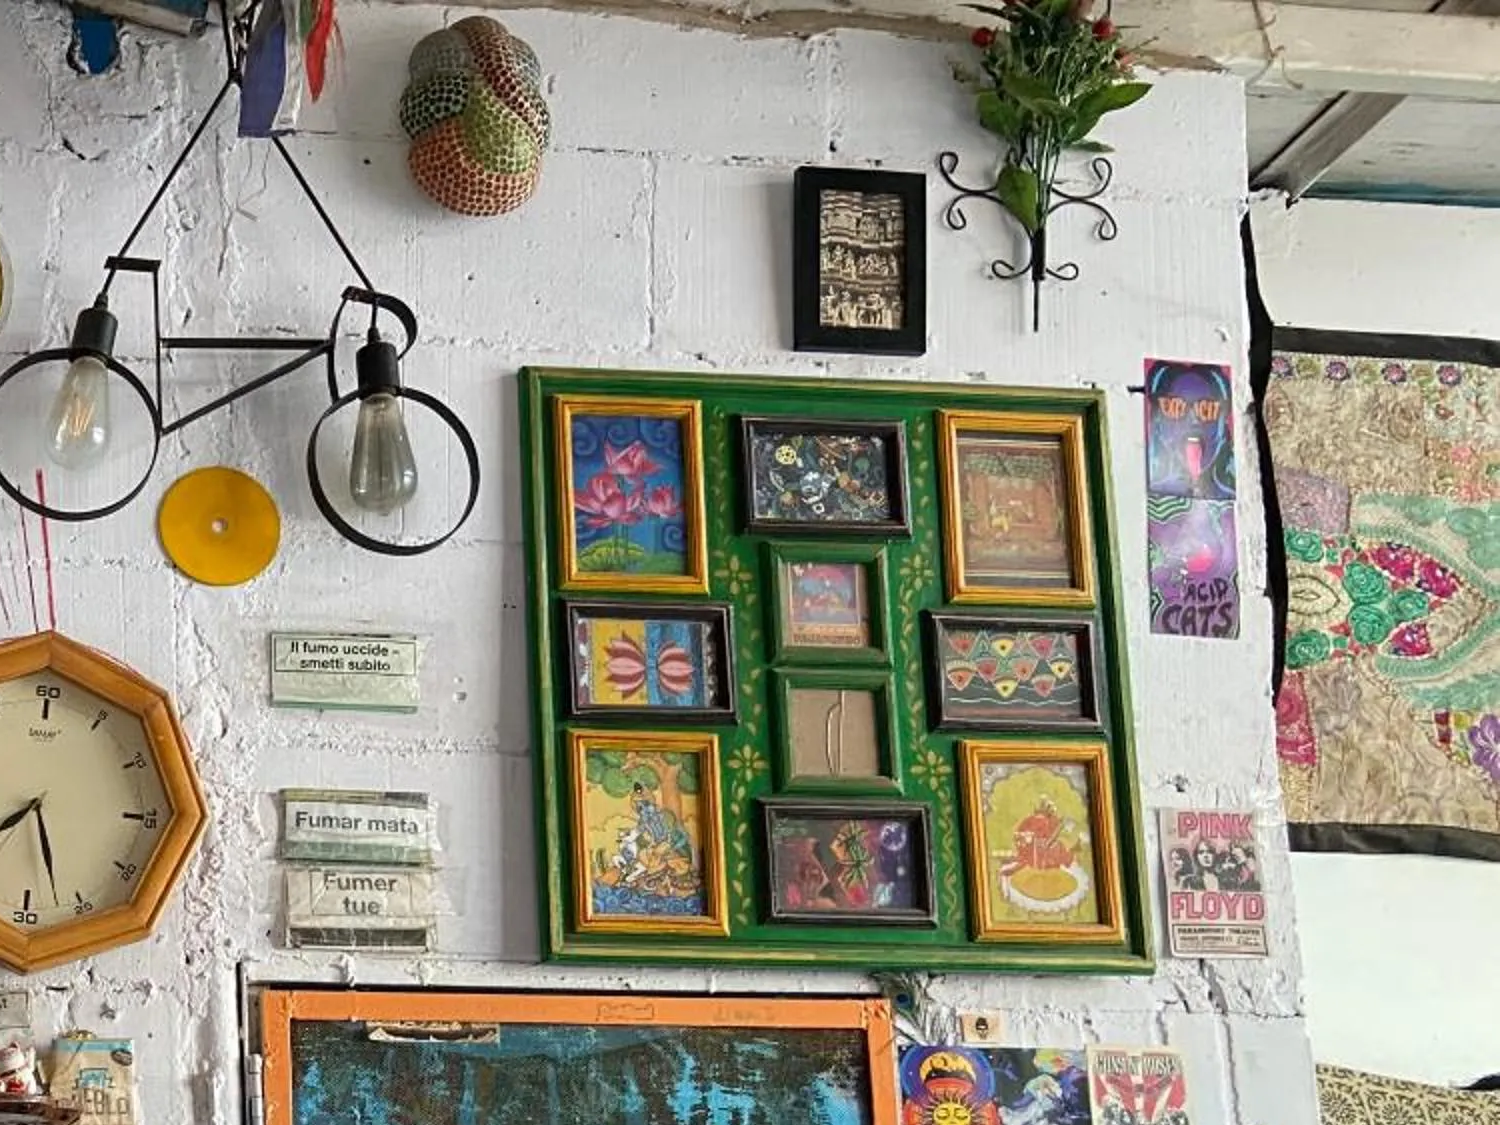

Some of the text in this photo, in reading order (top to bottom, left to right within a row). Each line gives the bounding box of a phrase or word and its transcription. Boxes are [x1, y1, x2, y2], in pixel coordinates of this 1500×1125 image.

[1186, 577, 1229, 602] ACID
[1162, 602, 1232, 636] CATS
[303, 642, 339, 655] fumo
[342, 642, 390, 656] uccide
[300, 657, 391, 672] smetti subito
[36, 685, 61, 699] 60
[98, 711, 108, 722] 5
[134, 752, 148, 769] 10
[144, 808, 158, 830] 15
[295, 810, 420, 835] Fumar mata
[1177, 811, 1254, 839] PINK
[121, 863, 137, 881] 20
[323, 872, 398, 892] Fumer
[75, 902, 94, 915] 25
[342, 896, 382, 915] tue
[1170, 891, 1265, 920] FLOYD
[13, 911, 38, 925] 30
